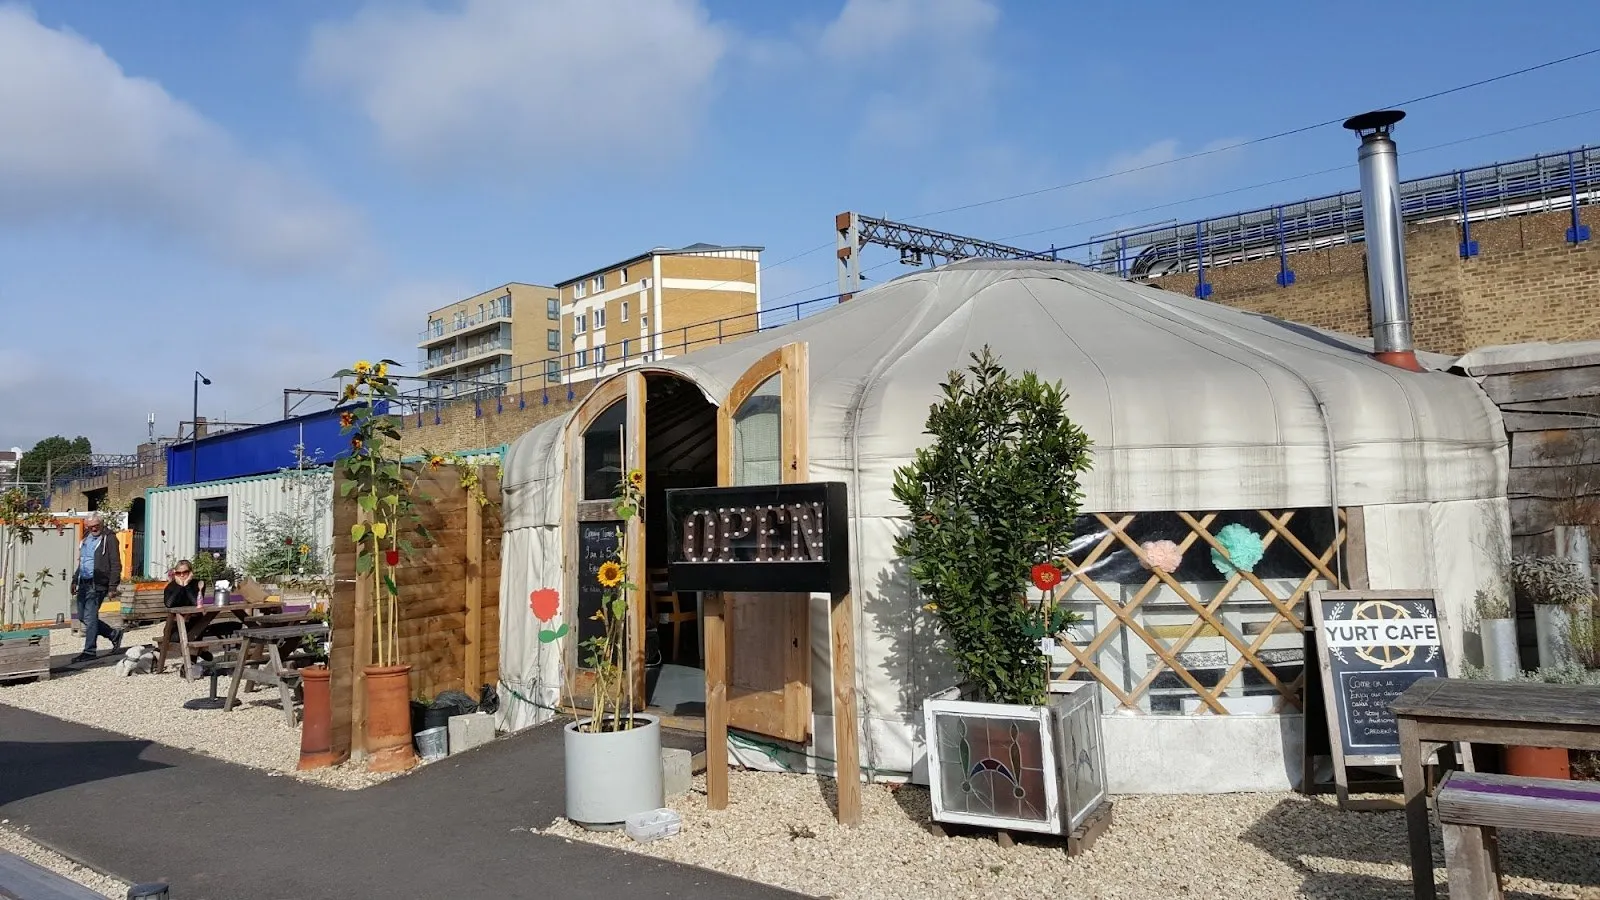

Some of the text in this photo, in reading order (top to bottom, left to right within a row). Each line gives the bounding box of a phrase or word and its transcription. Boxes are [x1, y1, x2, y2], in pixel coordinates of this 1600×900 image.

[683, 501, 824, 562] OPEN
[1325, 625, 1437, 641] YURT CAFE
[1349, 676, 1371, 689] Come
[1349, 690, 1369, 702] Enjoy
